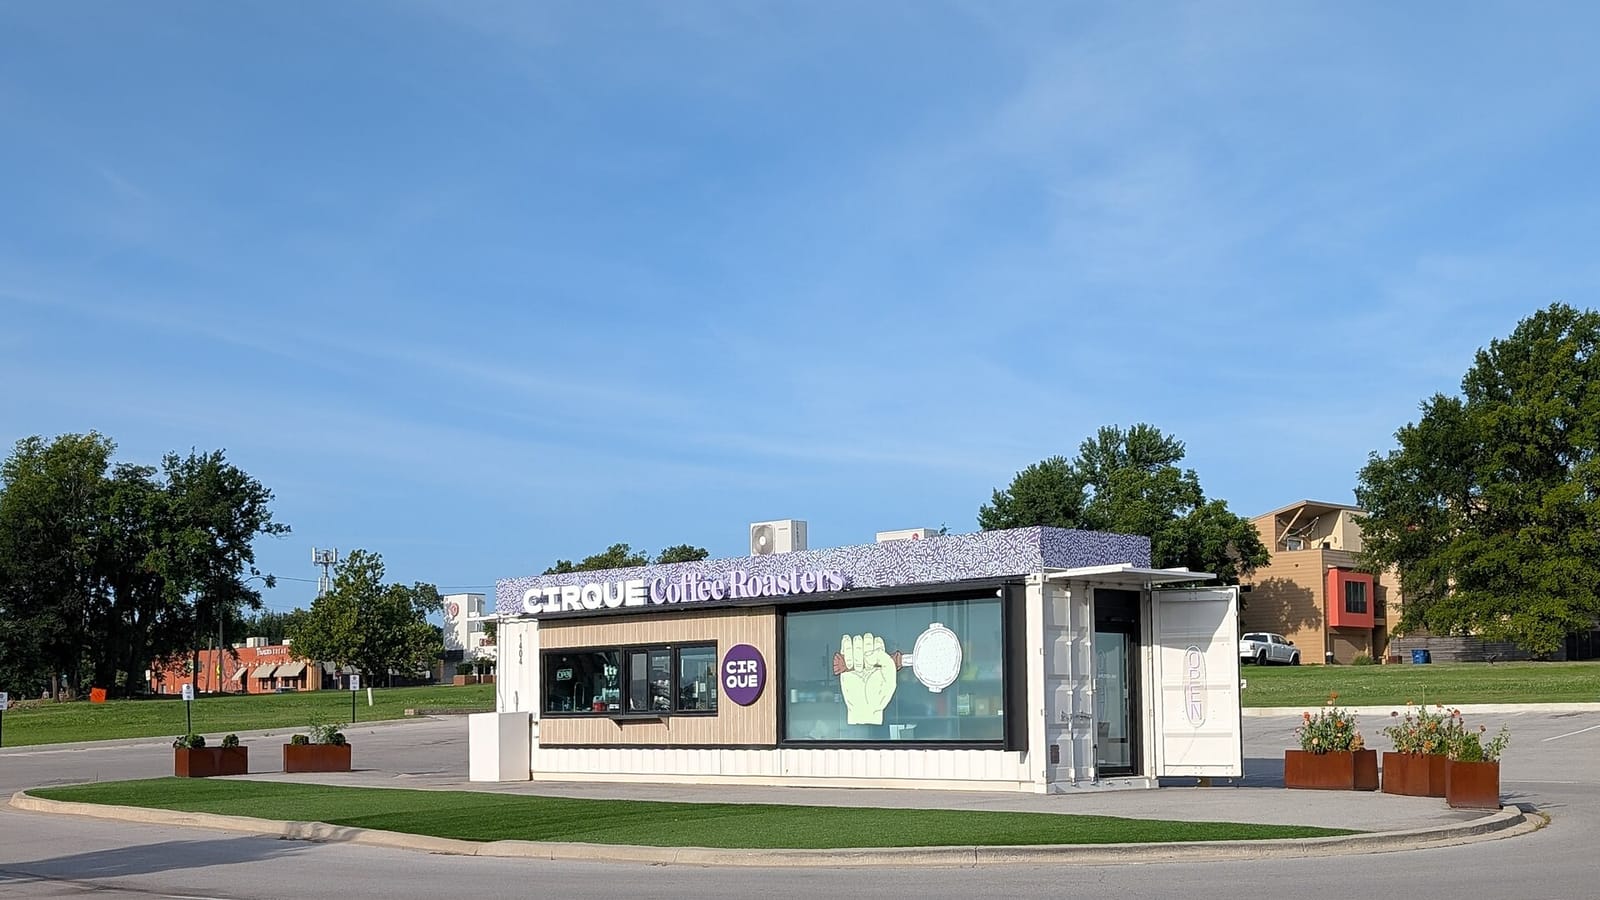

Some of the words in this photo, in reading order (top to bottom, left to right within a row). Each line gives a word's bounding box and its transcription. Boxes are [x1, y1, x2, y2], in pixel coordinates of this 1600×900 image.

[522, 579, 645, 614] CIRQUE
[650, 571, 724, 604] Coffee
[729, 568, 843, 599] Roasters
[726, 660, 757, 674] CIR
[726, 674, 758, 688] QUE
[1189, 652, 1202, 721] OPEN
